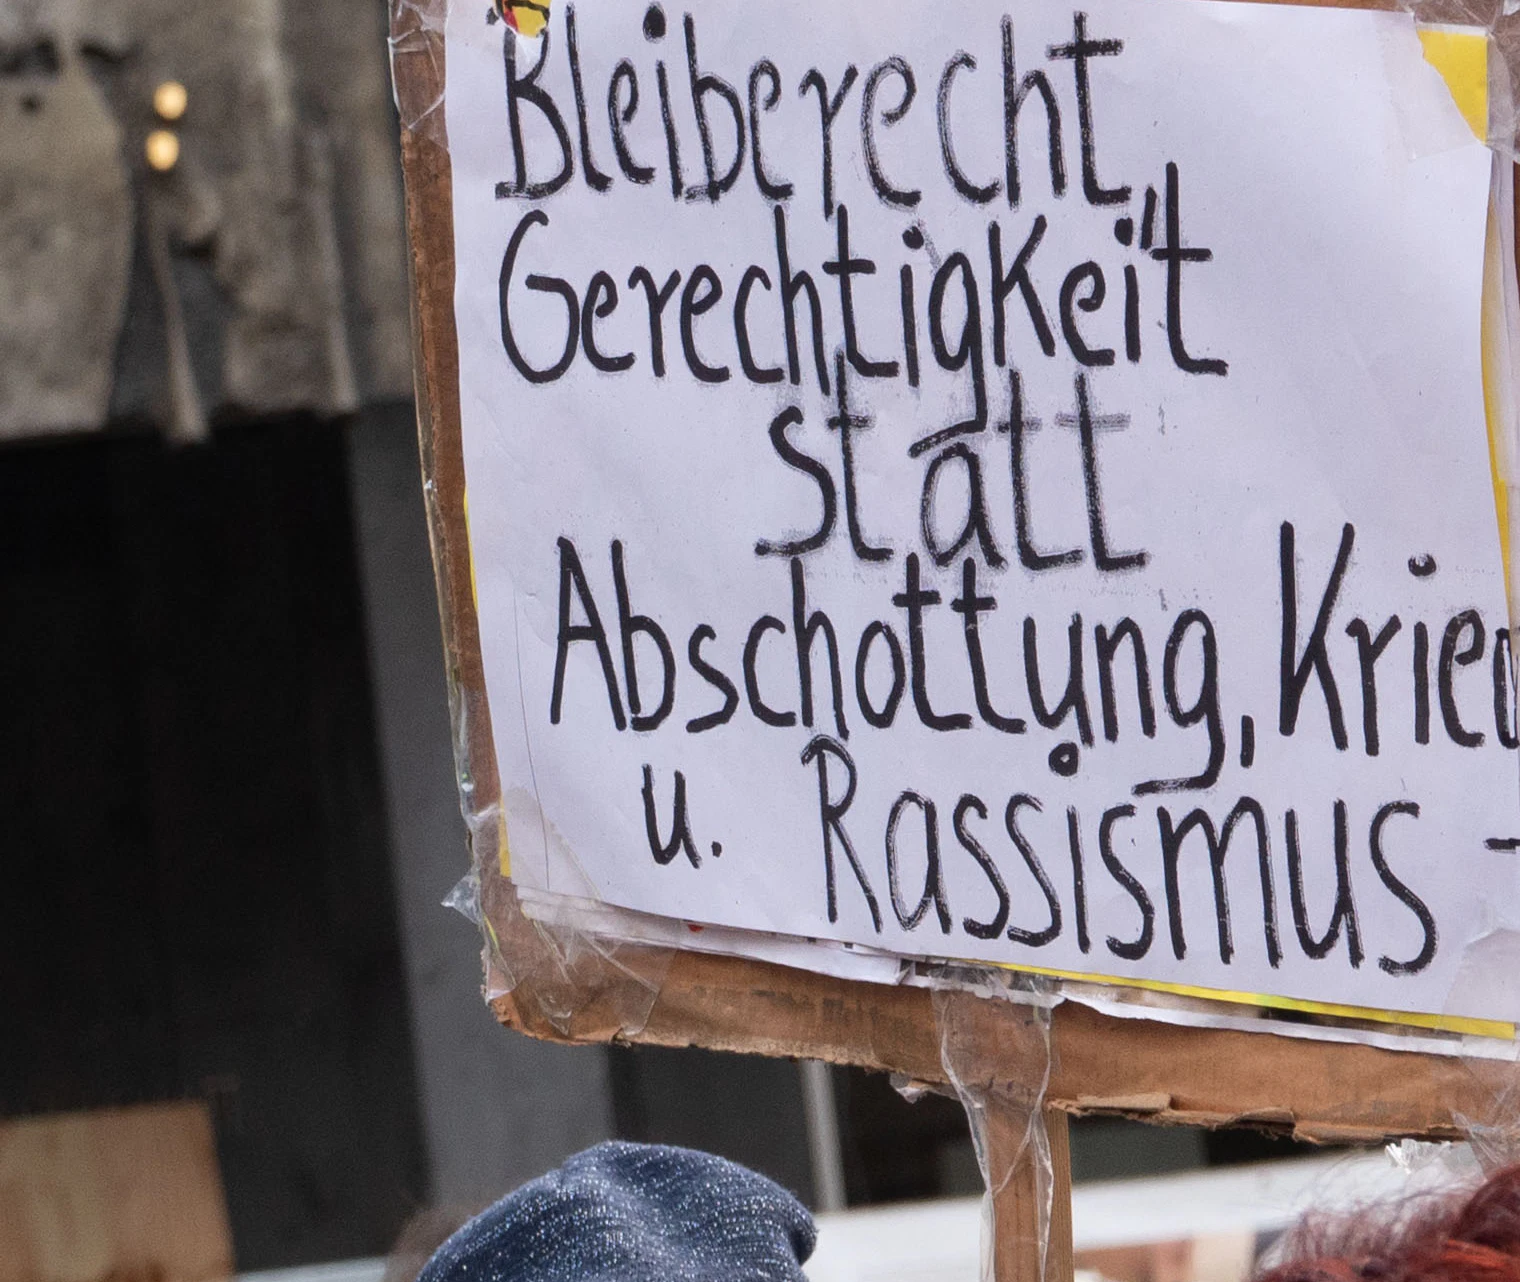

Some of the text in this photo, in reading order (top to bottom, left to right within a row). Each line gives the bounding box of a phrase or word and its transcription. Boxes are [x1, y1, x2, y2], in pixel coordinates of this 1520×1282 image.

[550, 536, 1254, 794] Abschottung,
[642, 734, 1440, 976] u. Rassismus
